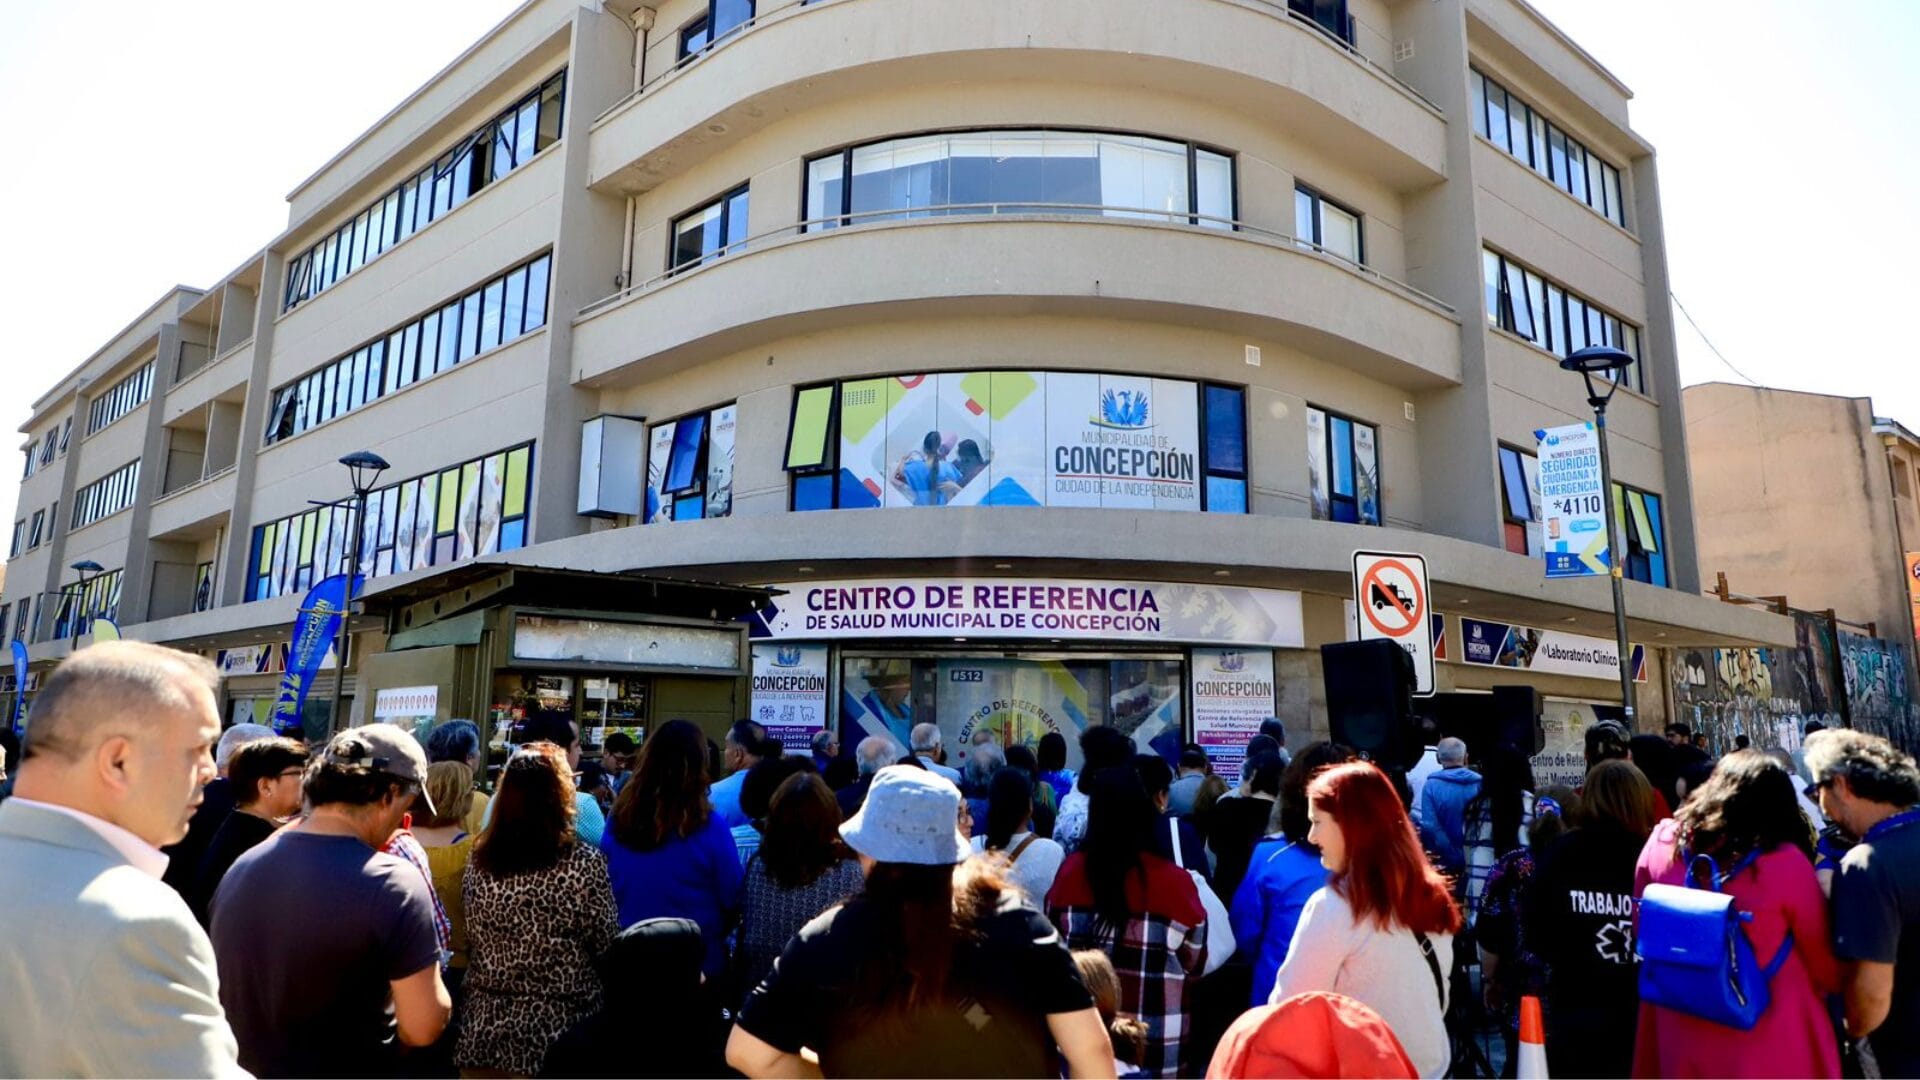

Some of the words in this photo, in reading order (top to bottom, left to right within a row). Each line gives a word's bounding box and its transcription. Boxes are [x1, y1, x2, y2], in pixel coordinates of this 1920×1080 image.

[1082, 432, 1156, 448] MUNICIPALIDAD
[1158, 436, 1169, 449] DE
[1055, 446, 1194, 480] CONCEPCIÓN
[1541, 455, 1597, 473] SEGURIDAD
[1542, 471, 1589, 485] CIUDADANA
[1591, 468, 1598, 479] Y
[1055, 479, 1092, 494] CIUDAD
[1095, 481, 1106, 494] DE
[1109, 482, 1122, 495] LA
[1124, 482, 1194, 499] INDEPENDENCIA
[1543, 480, 1599, 496] EMERGENCIA
[807, 586, 916, 611] CENTRO
[925, 586, 964, 609] DE
[973, 586, 1159, 612] REFERENCIA
[806, 615, 827, 629] DE
[831, 614, 886, 629] SALUD
[891, 613, 996, 629] MUNICIPAL
[1000, 613, 1026, 628] DE
[1031, 612, 1160, 632] CONCEPCIÓN
[1547, 644, 1591, 663] Laboratorio
[753, 674, 825, 690] CONCEPCIÓN
[953, 671, 981, 680] #512
[1195, 680, 1272, 696] CONCEPCIÓN
[958, 705, 991, 744] CENTRO
[992, 700, 1008, 711] DE
[1010, 699, 1061, 733] REFERENC
[1555, 752, 1566, 767] de
[1569, 889, 1632, 917] TRABAJO
